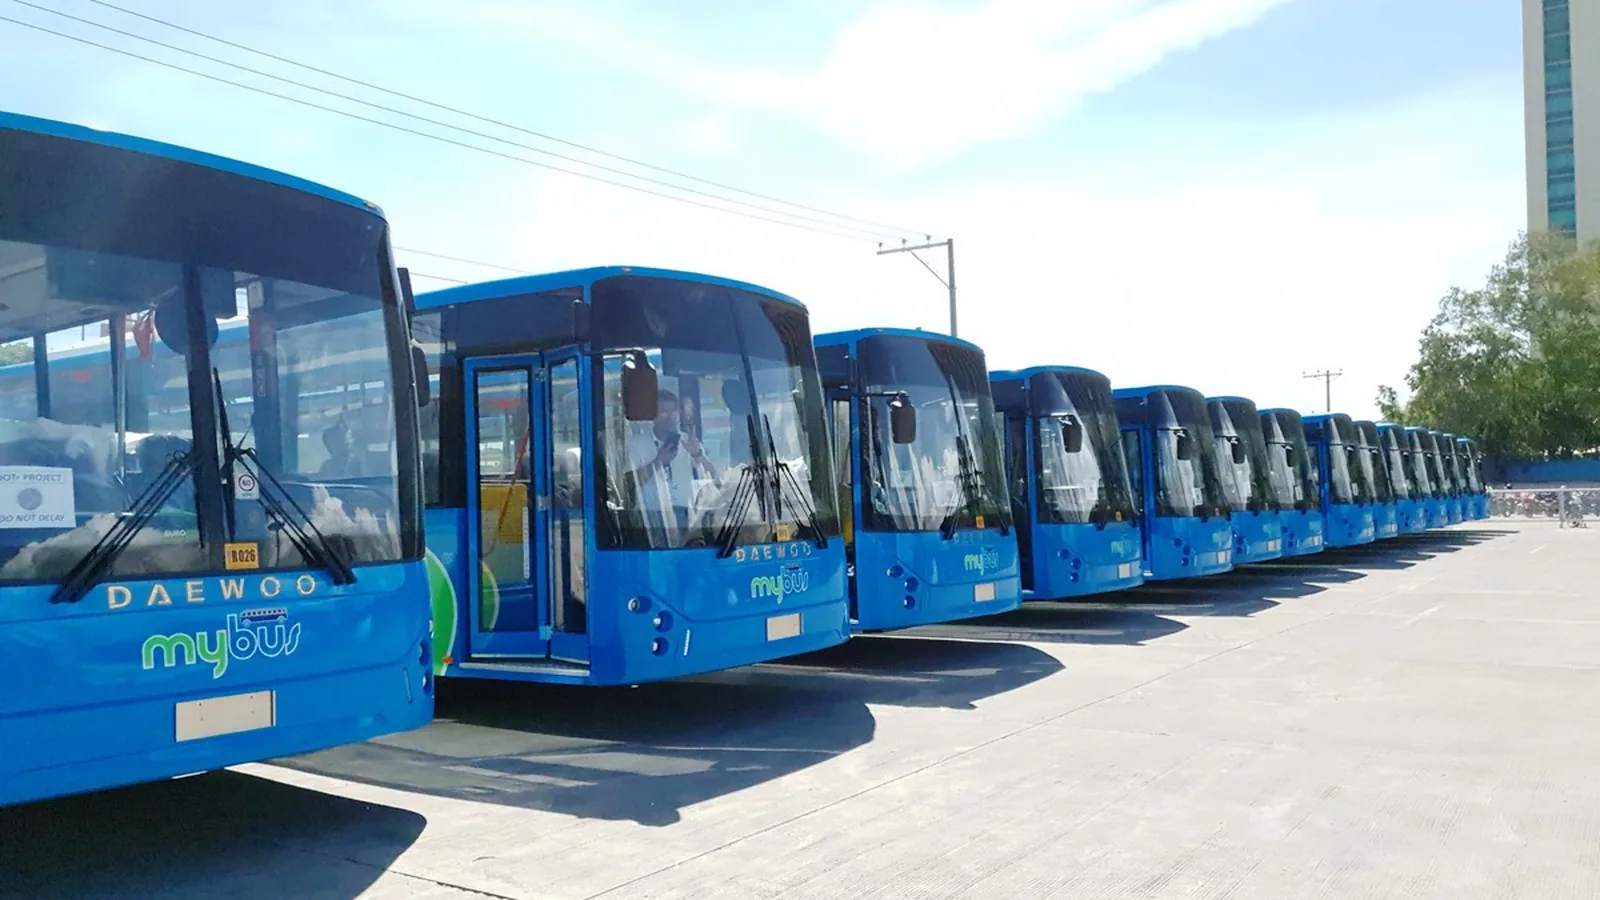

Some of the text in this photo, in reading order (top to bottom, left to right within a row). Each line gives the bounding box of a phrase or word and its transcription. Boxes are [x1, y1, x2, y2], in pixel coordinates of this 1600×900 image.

[23, 474, 62, 482] PROJECT
[16, 514, 37, 522] NOT
[39, 514, 64, 522] DELAY
[733, 541, 811, 562] DAEWOO
[107, 574, 316, 609] DAEWOO
[750, 565, 809, 605] mybus
[141, 612, 302, 680] mybus
